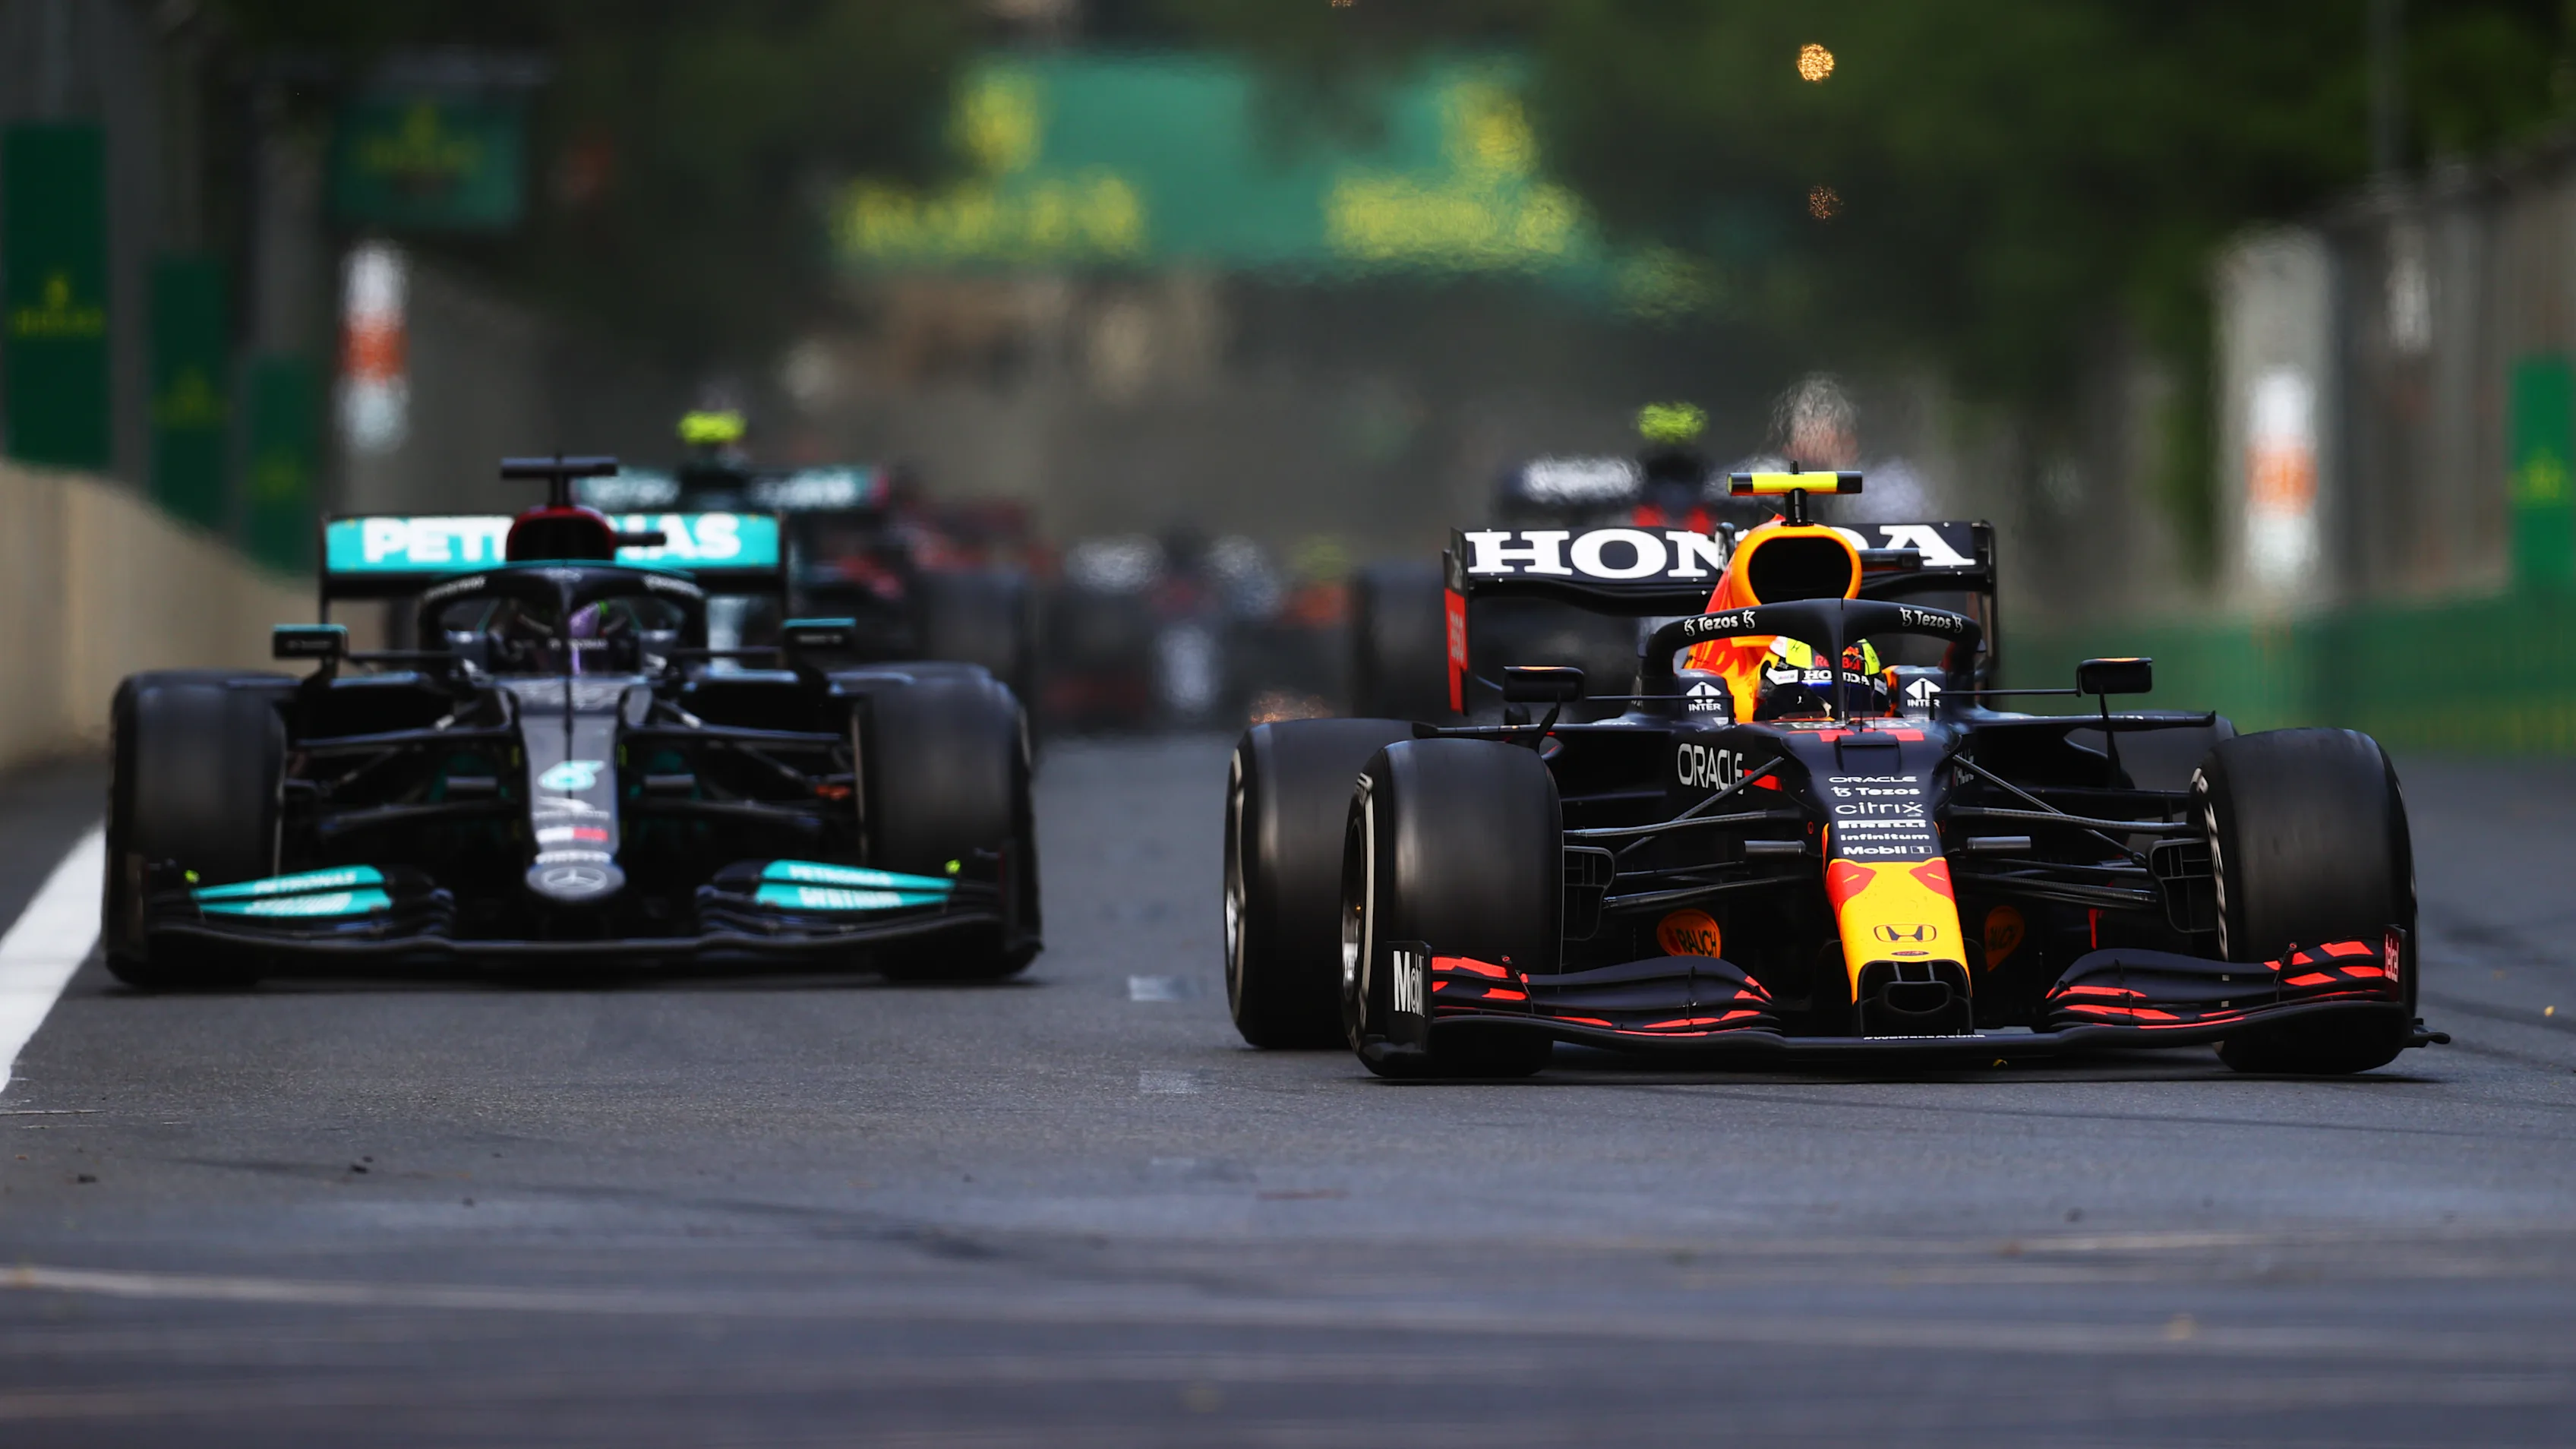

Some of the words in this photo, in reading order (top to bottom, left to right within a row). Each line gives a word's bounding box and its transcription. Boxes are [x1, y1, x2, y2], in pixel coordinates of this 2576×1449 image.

[1466, 525, 1976, 579] HONA
[1697, 615, 1738, 632] Tezos
[1914, 610, 1952, 630] Tezos
[1688, 702, 1722, 712] INTER
[1906, 699, 1940, 708] INTER
[1677, 743, 1744, 795] ORACLE
[1855, 787, 1921, 796] Tezos
[1835, 801, 1924, 815] citrix
[1837, 819, 1927, 829] PIRELLI
[1840, 833, 1930, 841] Infinitum
[1842, 845, 1907, 855] Mobil
[1675, 927, 1717, 958] RAUCH
[2385, 933, 2400, 983] telcel
[1393, 950, 1424, 1018] Mobil
